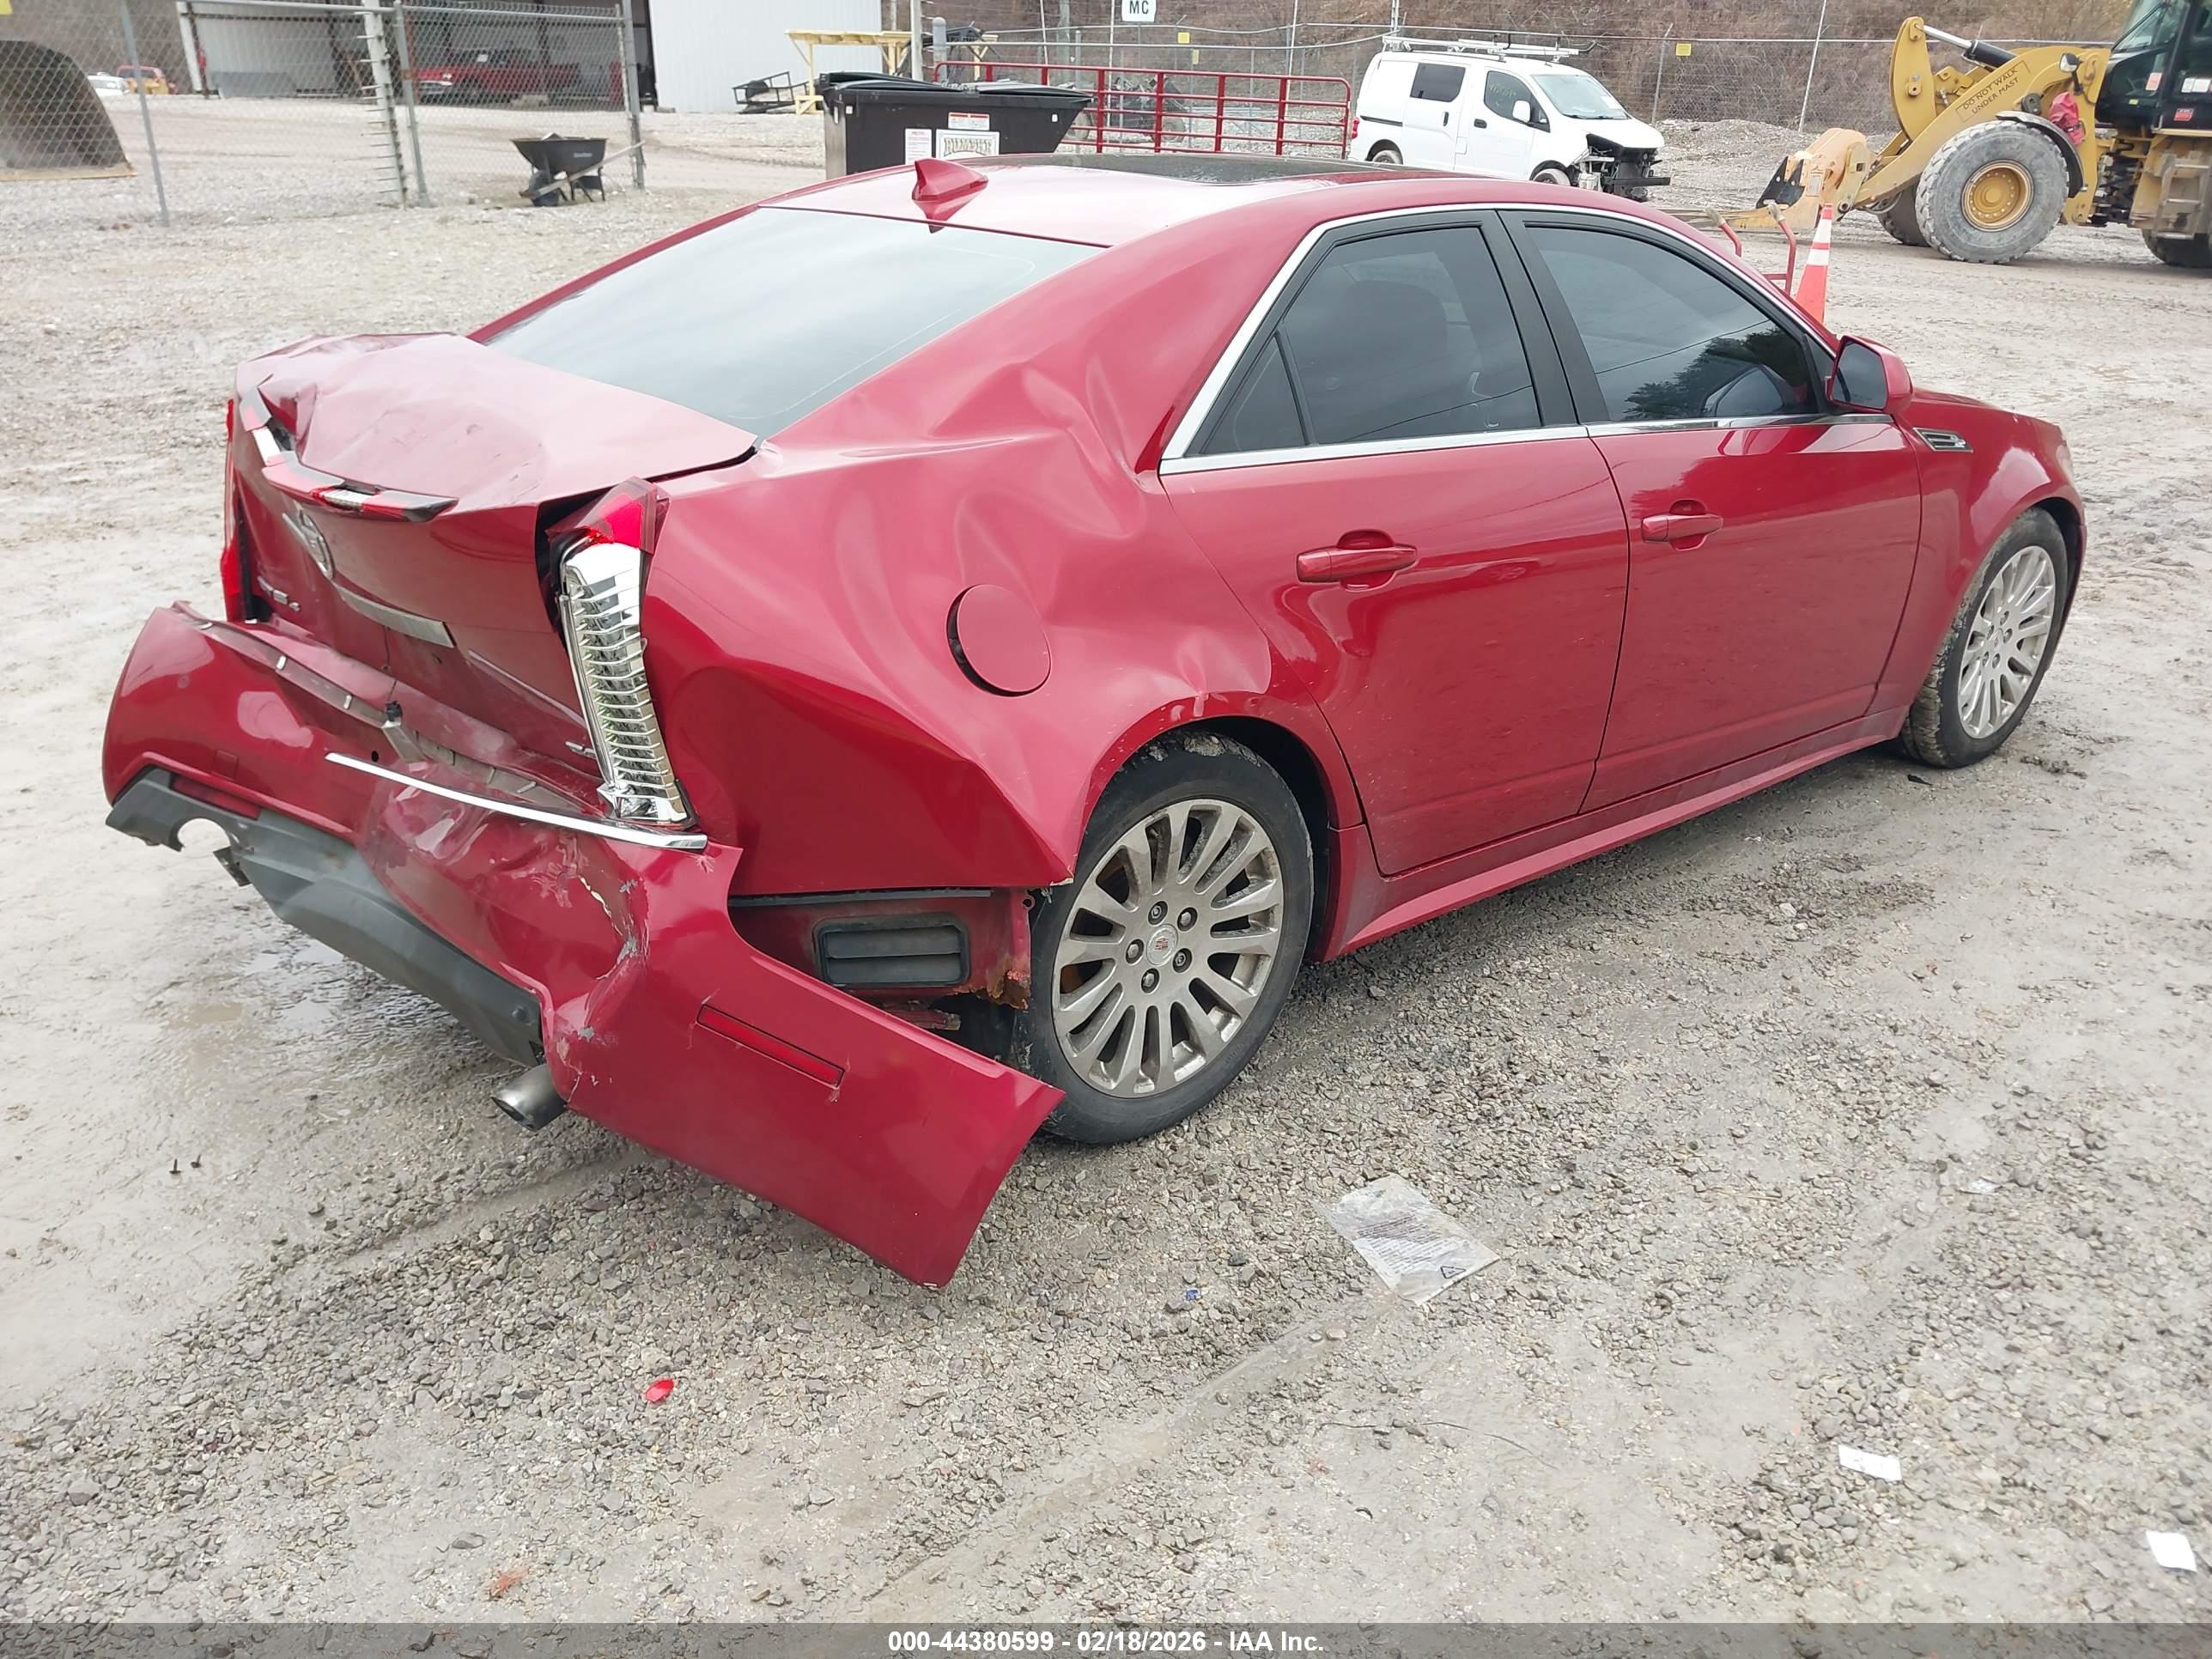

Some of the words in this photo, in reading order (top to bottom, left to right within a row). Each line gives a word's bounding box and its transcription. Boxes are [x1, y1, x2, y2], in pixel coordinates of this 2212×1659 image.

[1129, 0, 1149, 15] MC
[1963, 98, 1975, 110] DO
[1976, 84, 1993, 100] NOT
[1994, 68, 2018, 86] WALK
[1972, 93, 1997, 113] UNDER
[1998, 77, 2019, 94] MAST
